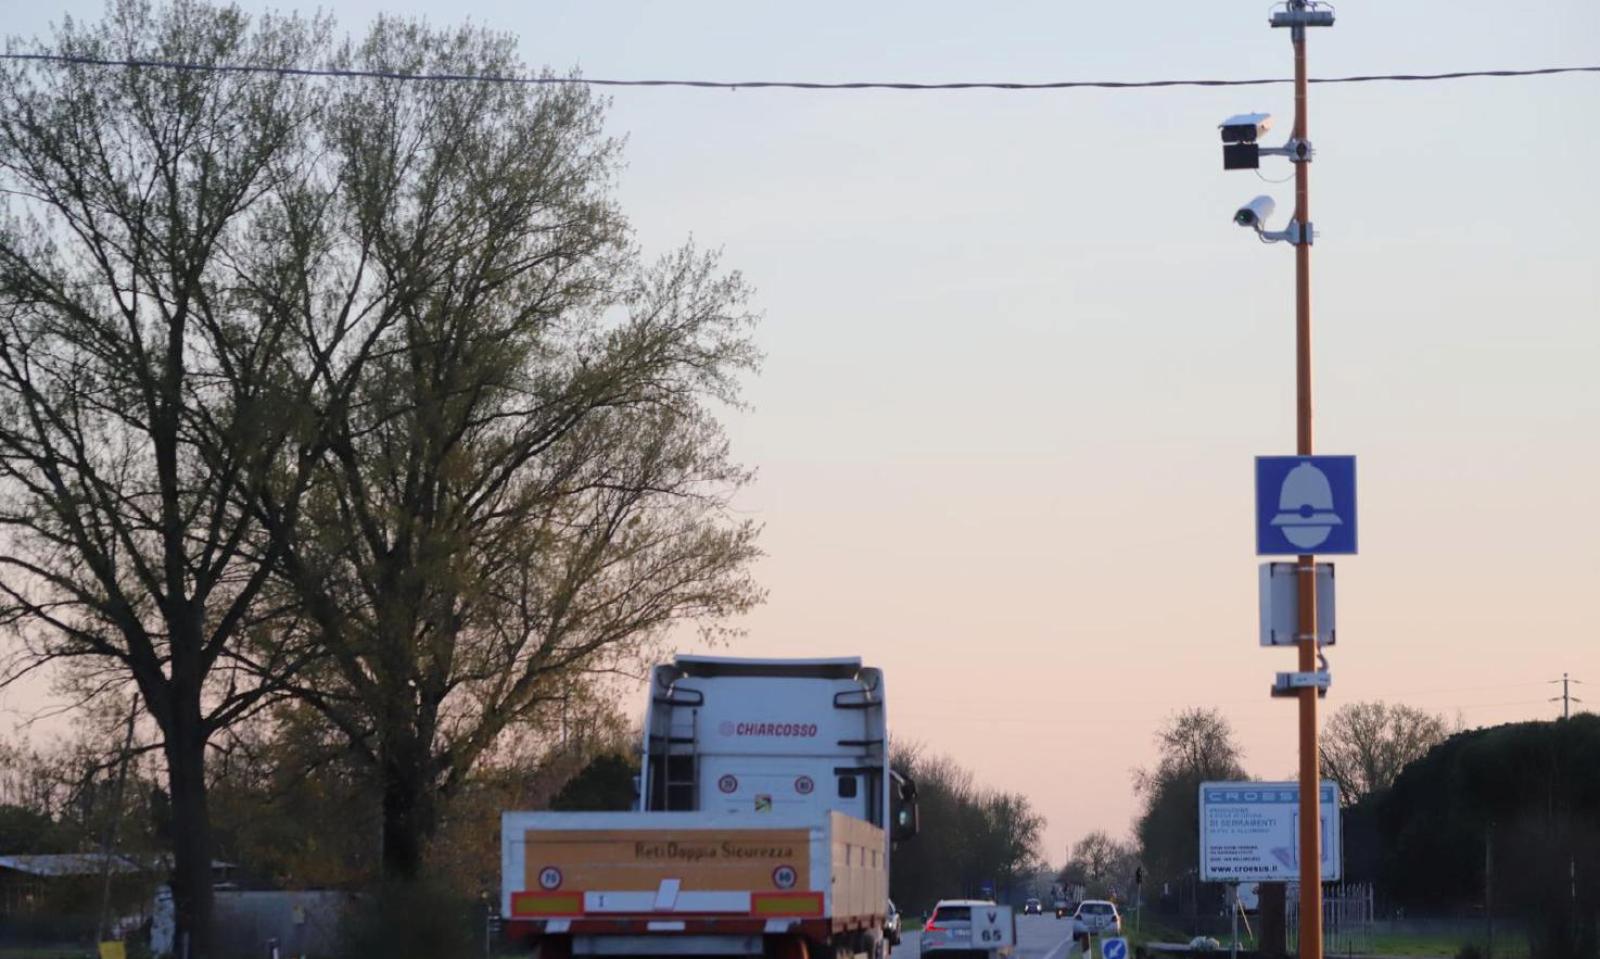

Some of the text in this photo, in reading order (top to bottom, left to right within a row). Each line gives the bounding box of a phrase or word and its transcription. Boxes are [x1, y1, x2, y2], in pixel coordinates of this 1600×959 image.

[736, 722, 818, 737] CHIARCOSSO
[1208, 791, 1329, 802] CROESS
[634, 841, 792, 863] Reti Doppia Sicurezza
[986, 911, 997, 924] V
[981, 929, 1002, 941] 65
